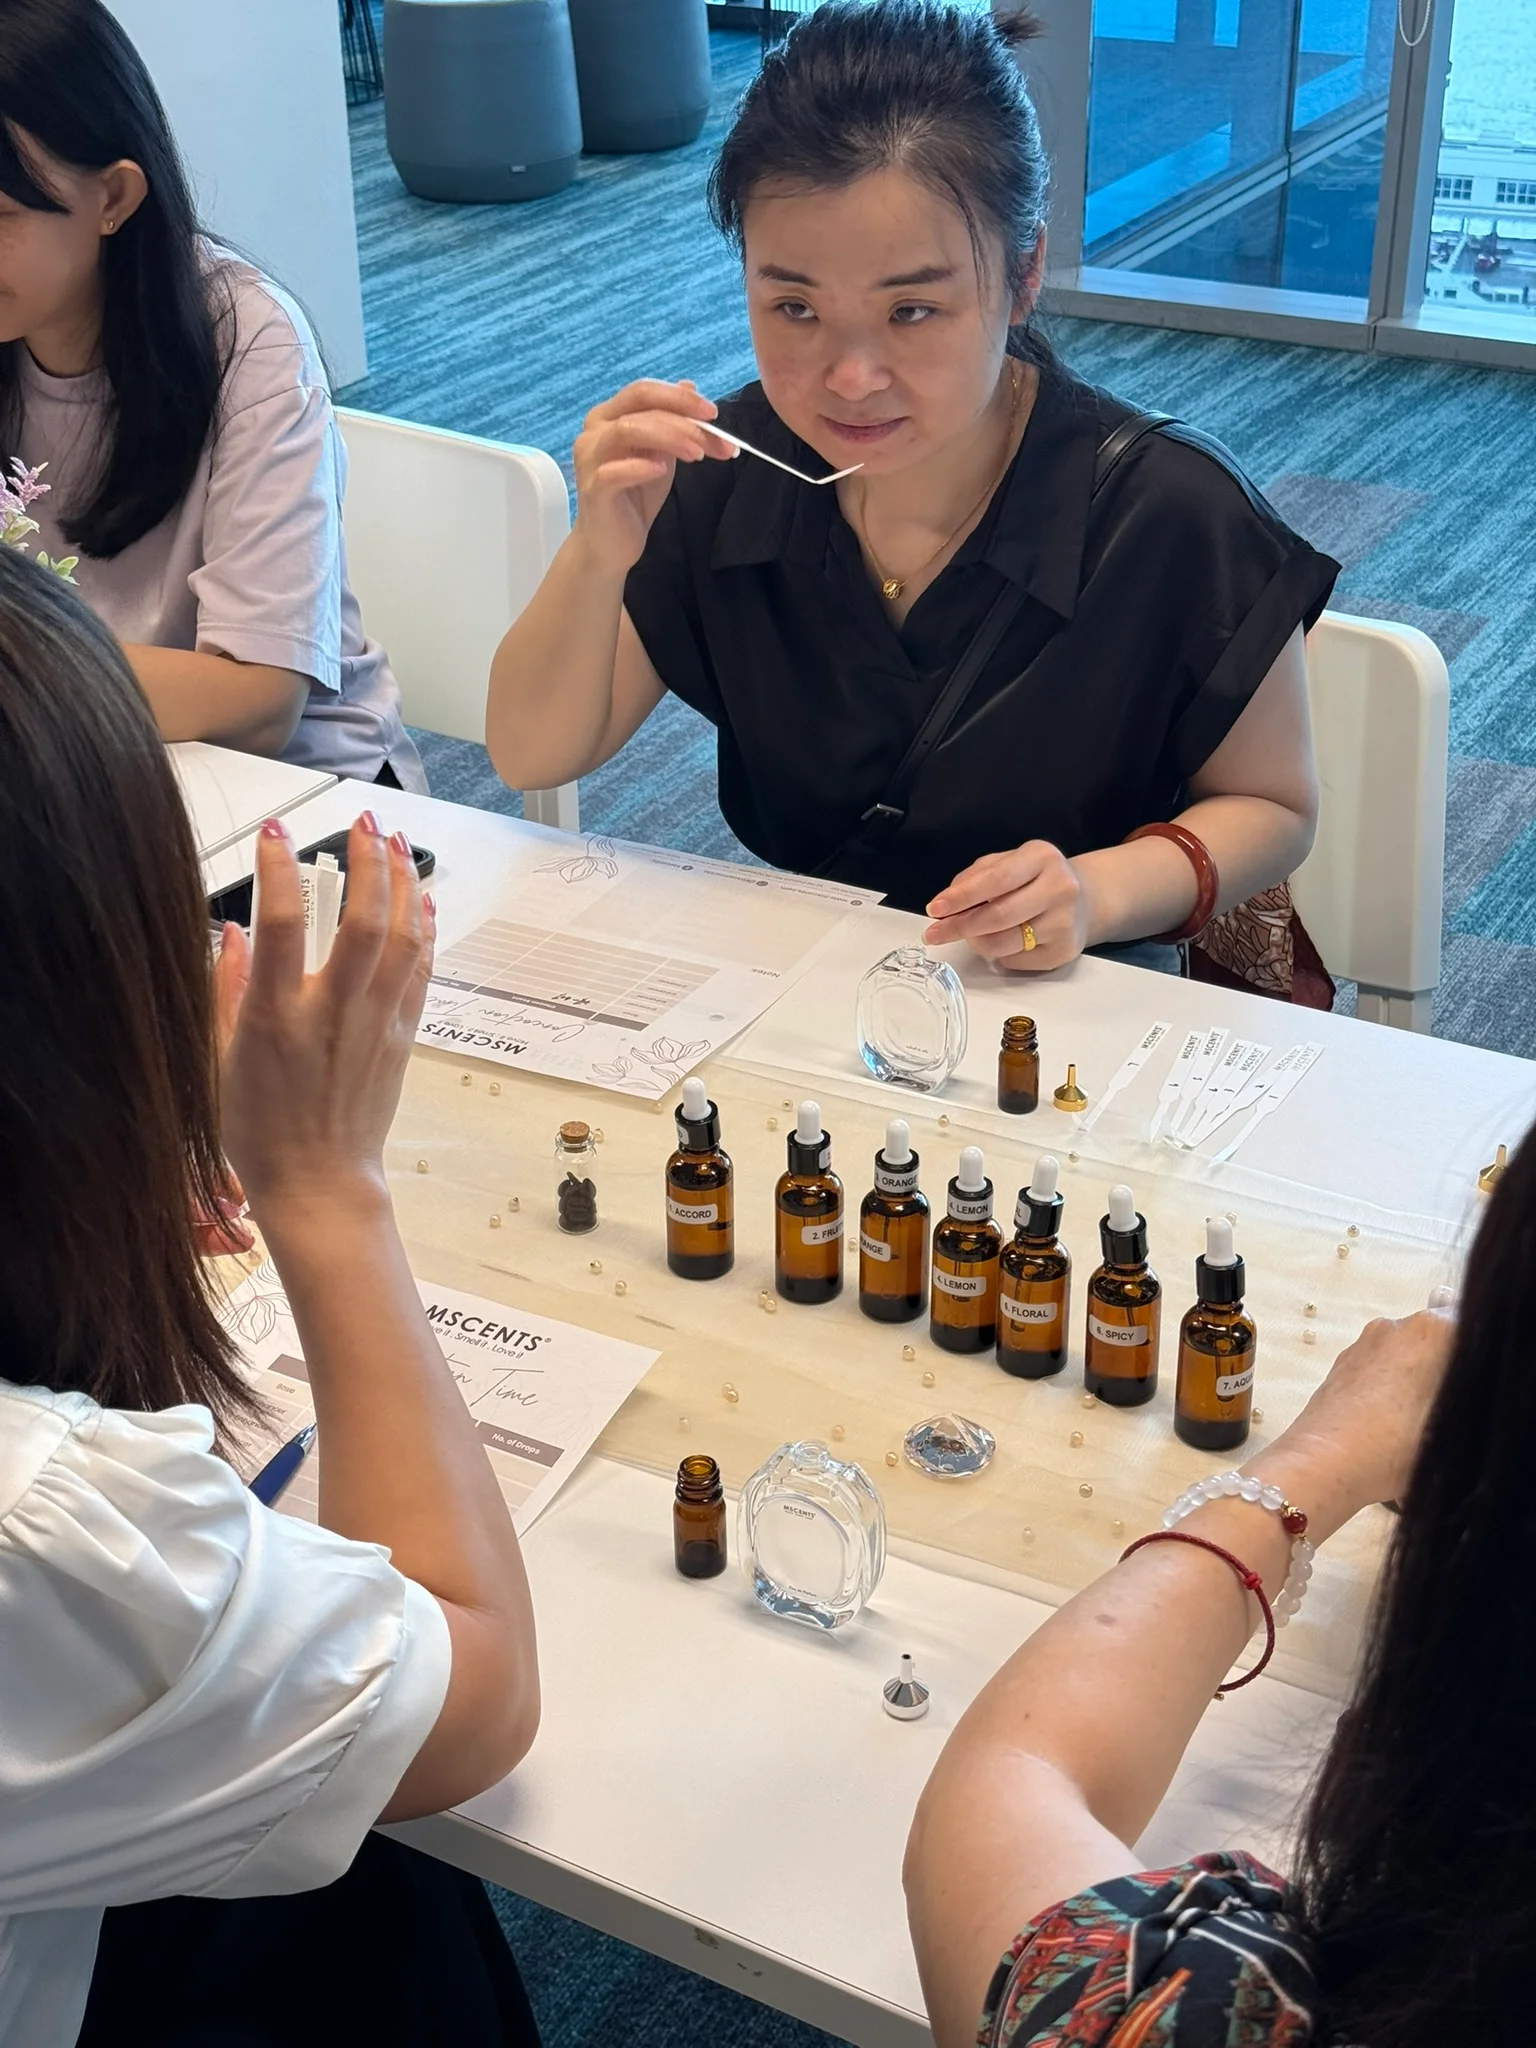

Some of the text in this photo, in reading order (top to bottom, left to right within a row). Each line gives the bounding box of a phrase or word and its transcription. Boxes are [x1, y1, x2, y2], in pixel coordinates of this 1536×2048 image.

[478, 1009, 585, 1042] Concoction
[421, 1023, 527, 1055] MSCENTS
[881, 1174, 917, 1187] ORANGE
[675, 1208, 712, 1219] ACCORD
[956, 1203, 988, 1215] LEMON
[812, 1232, 820, 1240] 2.
[944, 1278, 977, 1290] LEMON
[1011, 1306, 1049, 1318] FLORAL
[1105, 1330, 1136, 1341] SPICY
[454, 1332, 481, 1346] Smell
[492, 1344, 516, 1358] Love
[275, 1383, 296, 1394] Base
[469, 1368, 545, 1407] Time
[1223, 1382, 1231, 1391] 7.
[492, 1432, 540, 1456] No. of Drops
[783, 1504, 815, 1519] MSCENTS
